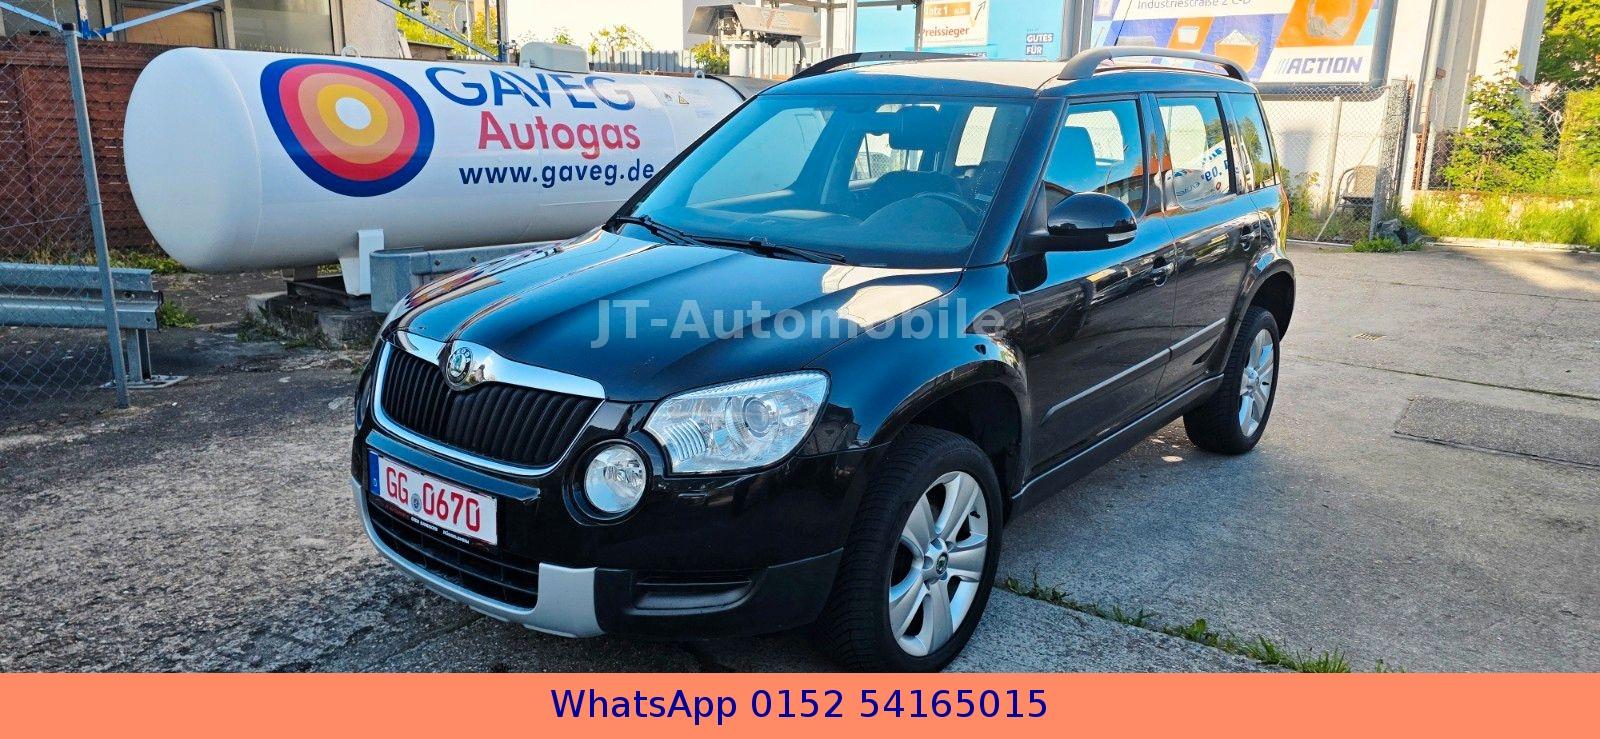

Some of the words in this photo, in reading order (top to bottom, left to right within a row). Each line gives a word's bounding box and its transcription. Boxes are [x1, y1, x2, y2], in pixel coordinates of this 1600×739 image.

[1026, 33, 1053, 43] GUTES
[1026, 44, 1043, 55] FÜR
[1286, 57, 1363, 74] ACTION
[425, 66, 636, 111] GAVEG
[478, 110, 641, 160] Autogas
[459, 158, 655, 189] www.gaveg.de
[386, 466, 409, 505] GG
[422, 482, 480, 532] 0670
